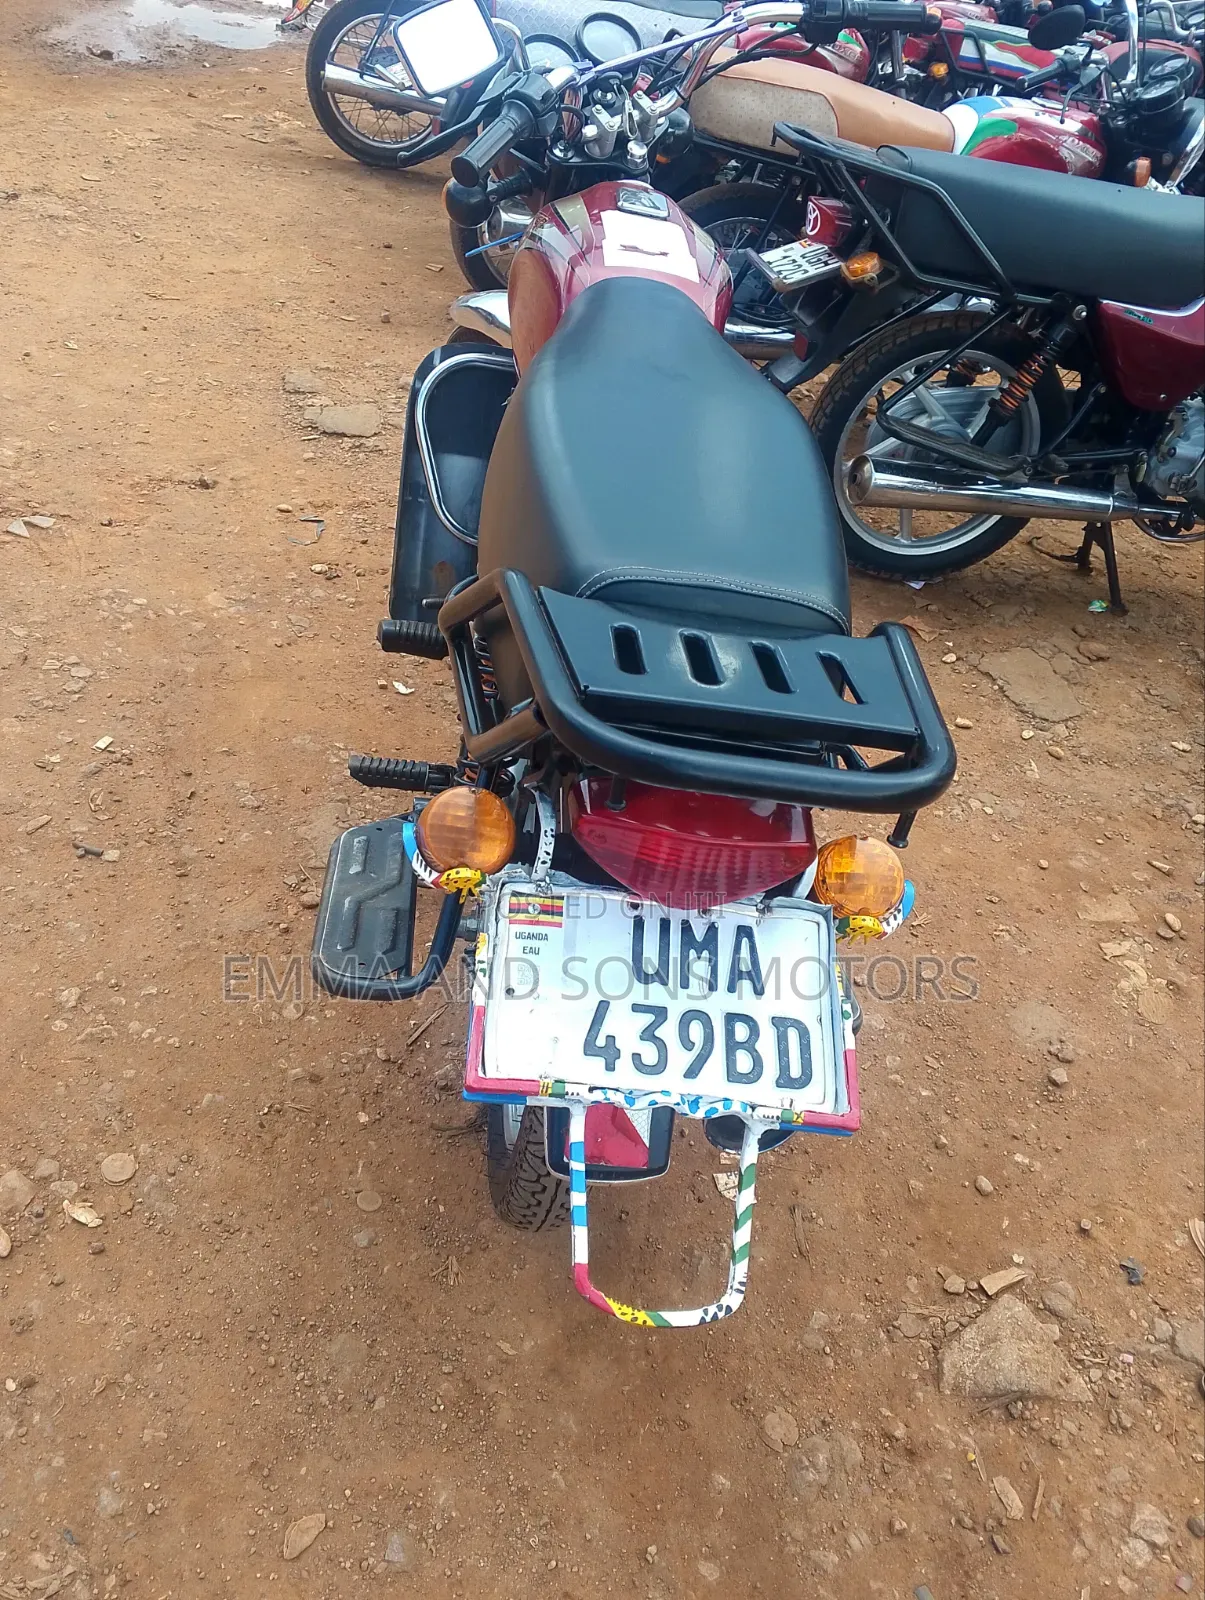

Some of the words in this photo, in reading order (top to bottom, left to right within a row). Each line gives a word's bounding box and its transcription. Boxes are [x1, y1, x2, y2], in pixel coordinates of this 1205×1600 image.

[766, 255, 810, 280] 172C
[800, 246, 839, 271] UGH
[514, 931, 549, 942] UGANDA
[522, 945, 541, 956] EAU
[631, 915, 765, 996] UMA
[583, 1000, 814, 1089] 439BD
